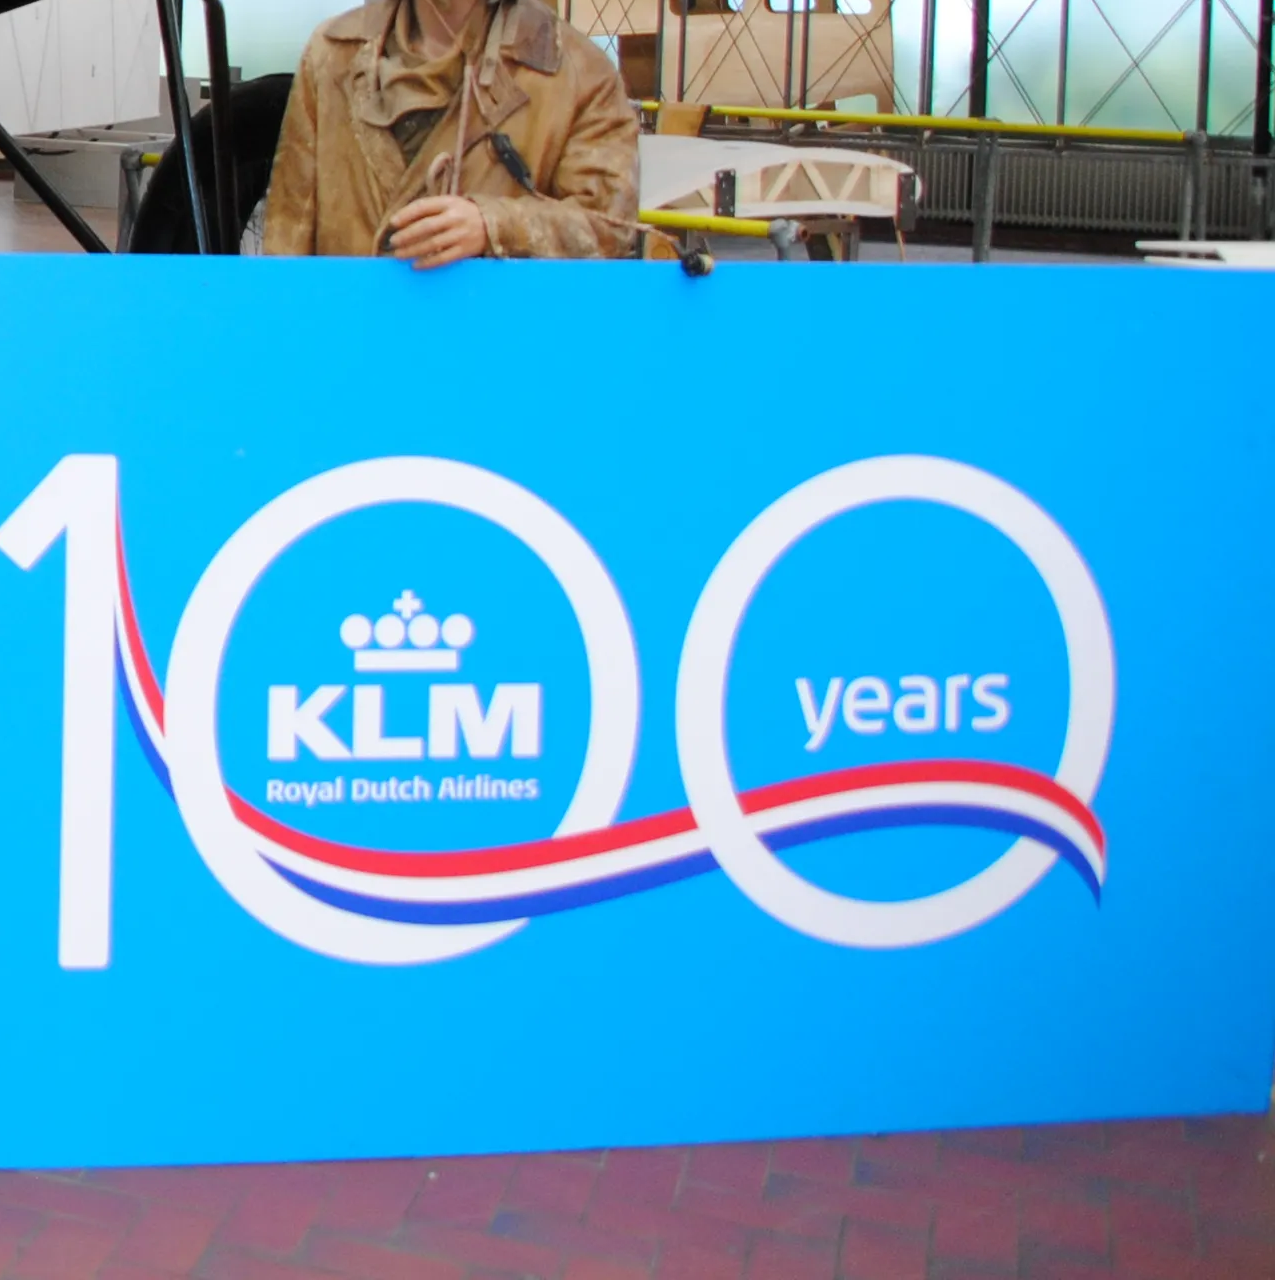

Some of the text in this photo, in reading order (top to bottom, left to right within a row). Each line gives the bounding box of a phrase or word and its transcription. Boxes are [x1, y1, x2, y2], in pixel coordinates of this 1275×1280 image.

[267, 682, 541, 761] KLM
[794, 672, 1011, 752] years
[266, 774, 540, 807] Royal Dutch Airlines
